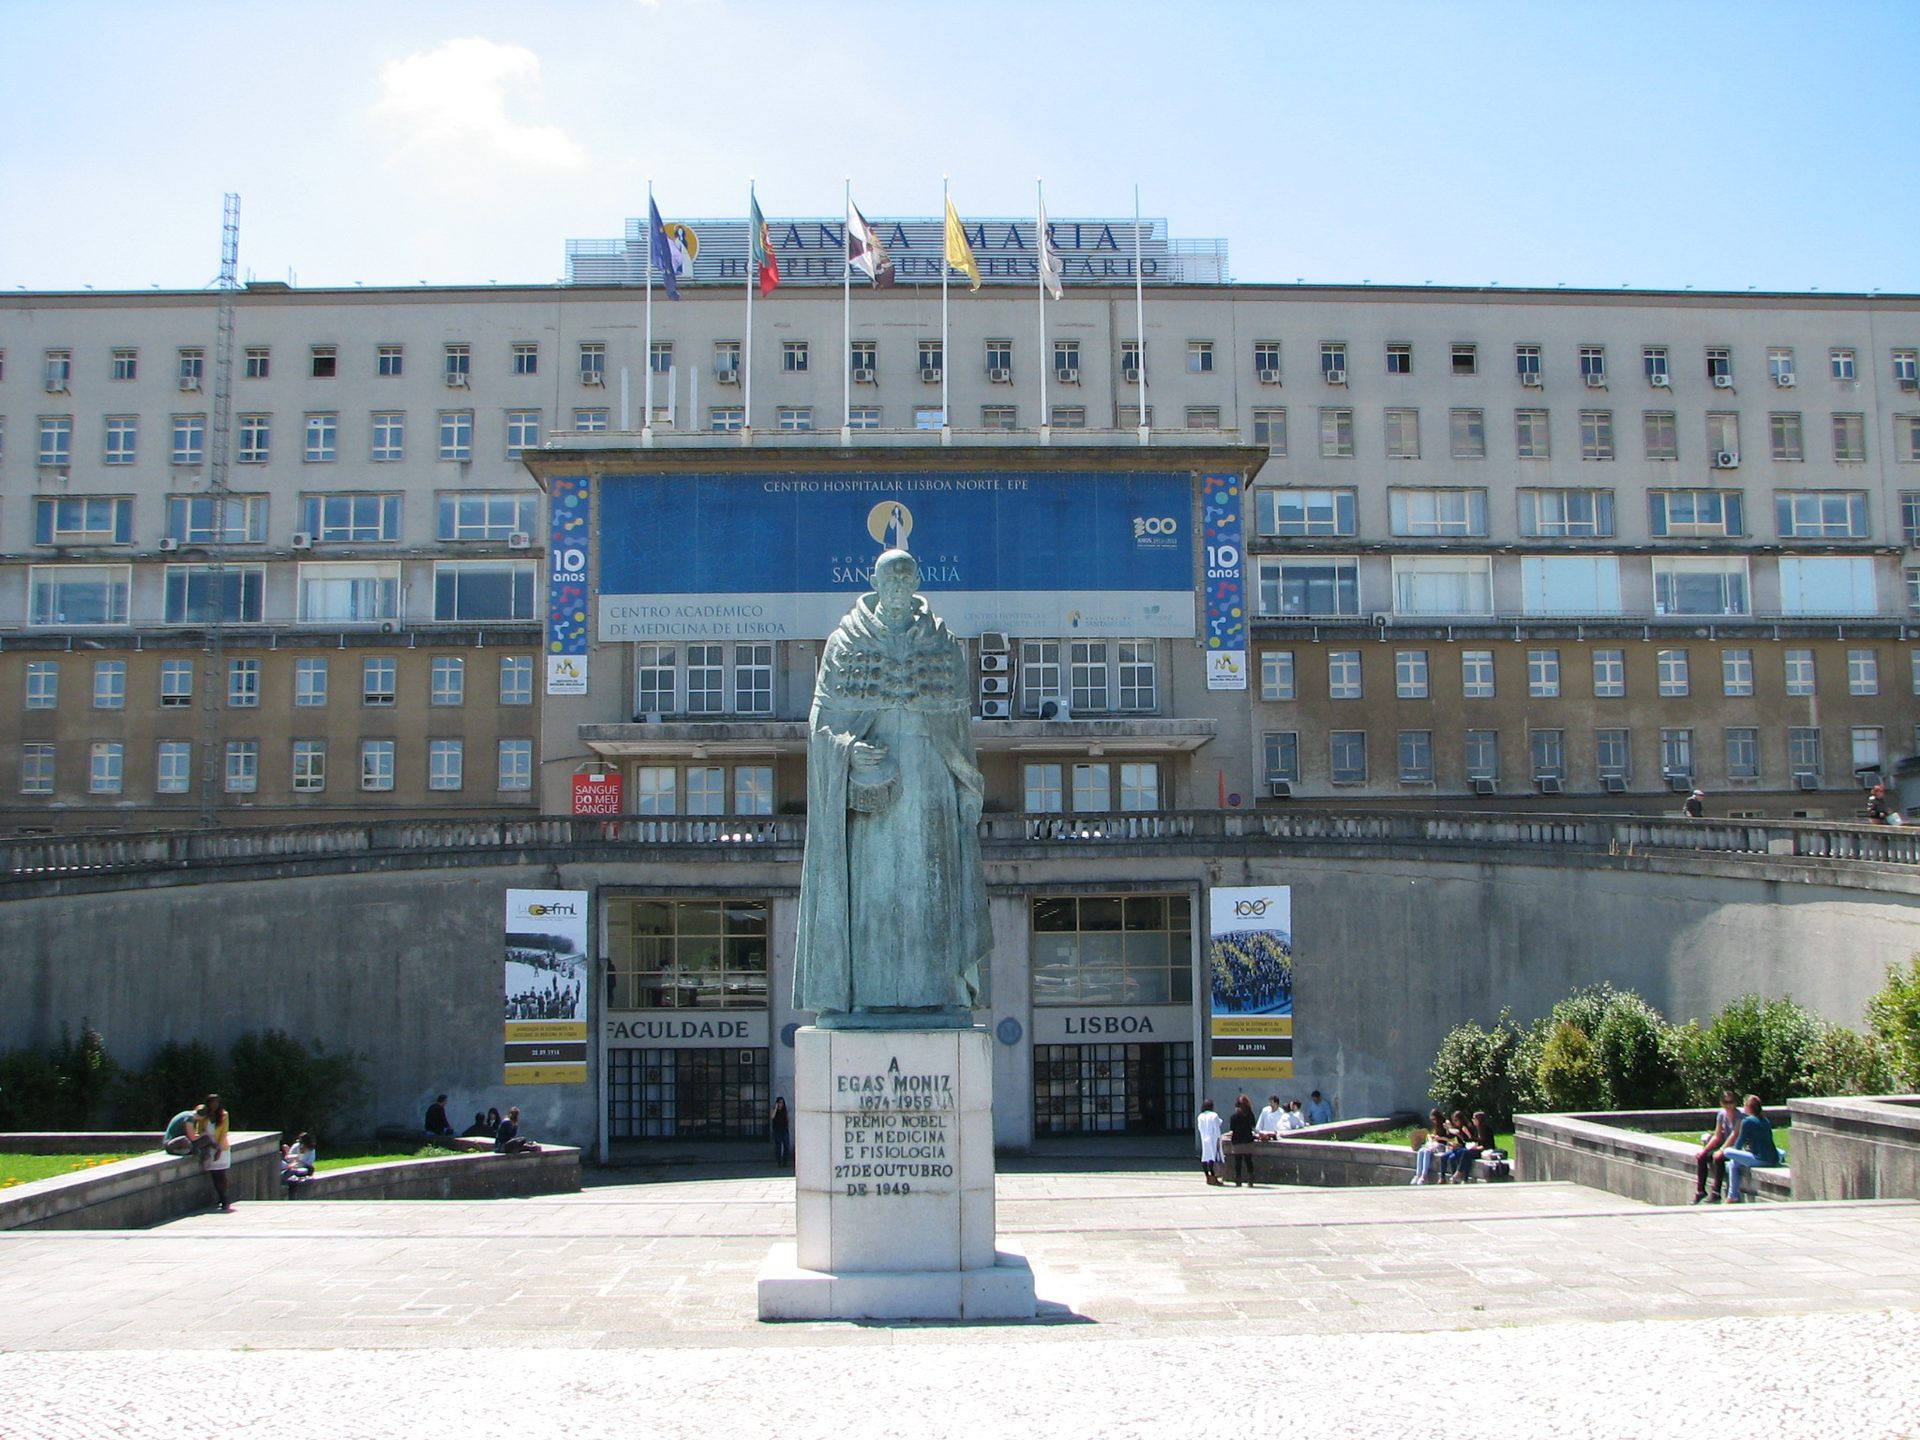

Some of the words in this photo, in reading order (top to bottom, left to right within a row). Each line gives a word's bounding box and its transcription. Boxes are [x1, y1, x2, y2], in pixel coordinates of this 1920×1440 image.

[782, 222, 911, 249] ANA
[763, 481, 819, 493] CENTRO
[823, 480, 903, 492] HOSPITALAR
[907, 480, 952, 490] LISBOA
[1007, 479, 1029, 490] EPE
[553, 549, 585, 572] 10
[1207, 545, 1239, 568] 10
[553, 573, 585, 582] anos
[832, 566, 875, 583] SAN
[916, 566, 960, 582] ARIA
[1207, 569, 1240, 578] anos
[610, 606, 671, 618] CENTRO
[610, 624, 628, 635] DE
[633, 623, 708, 635] MEDICINA
[713, 623, 731, 634] DE
[736, 622, 786, 634] LISBOA
[575, 785, 618, 795] SANGUE
[575, 795, 592, 804] DO
[595, 795, 618, 804] MEU
[575, 805, 618, 814] SANGUE
[1065, 1016, 1154, 1034] LISBOA
[888, 1056, 900, 1072] A
[838, 1076, 885, 1092] EGAS
[894, 1075, 951, 1093] MONIZ
[860, 1095, 932, 1110] 1874-1955
[901, 1115, 947, 1128] NOBEL
[845, 1131, 865, 1143] DE
[874, 1131, 945, 1143] MEDICINA
[845, 1147, 854, 1159] E
[861, 1146, 945, 1158] FISIOLOGIA
[873, 1164, 953, 1177] OUTUBRO
[847, 1184, 866, 1196] DE
[876, 1182, 910, 1195] 1949
